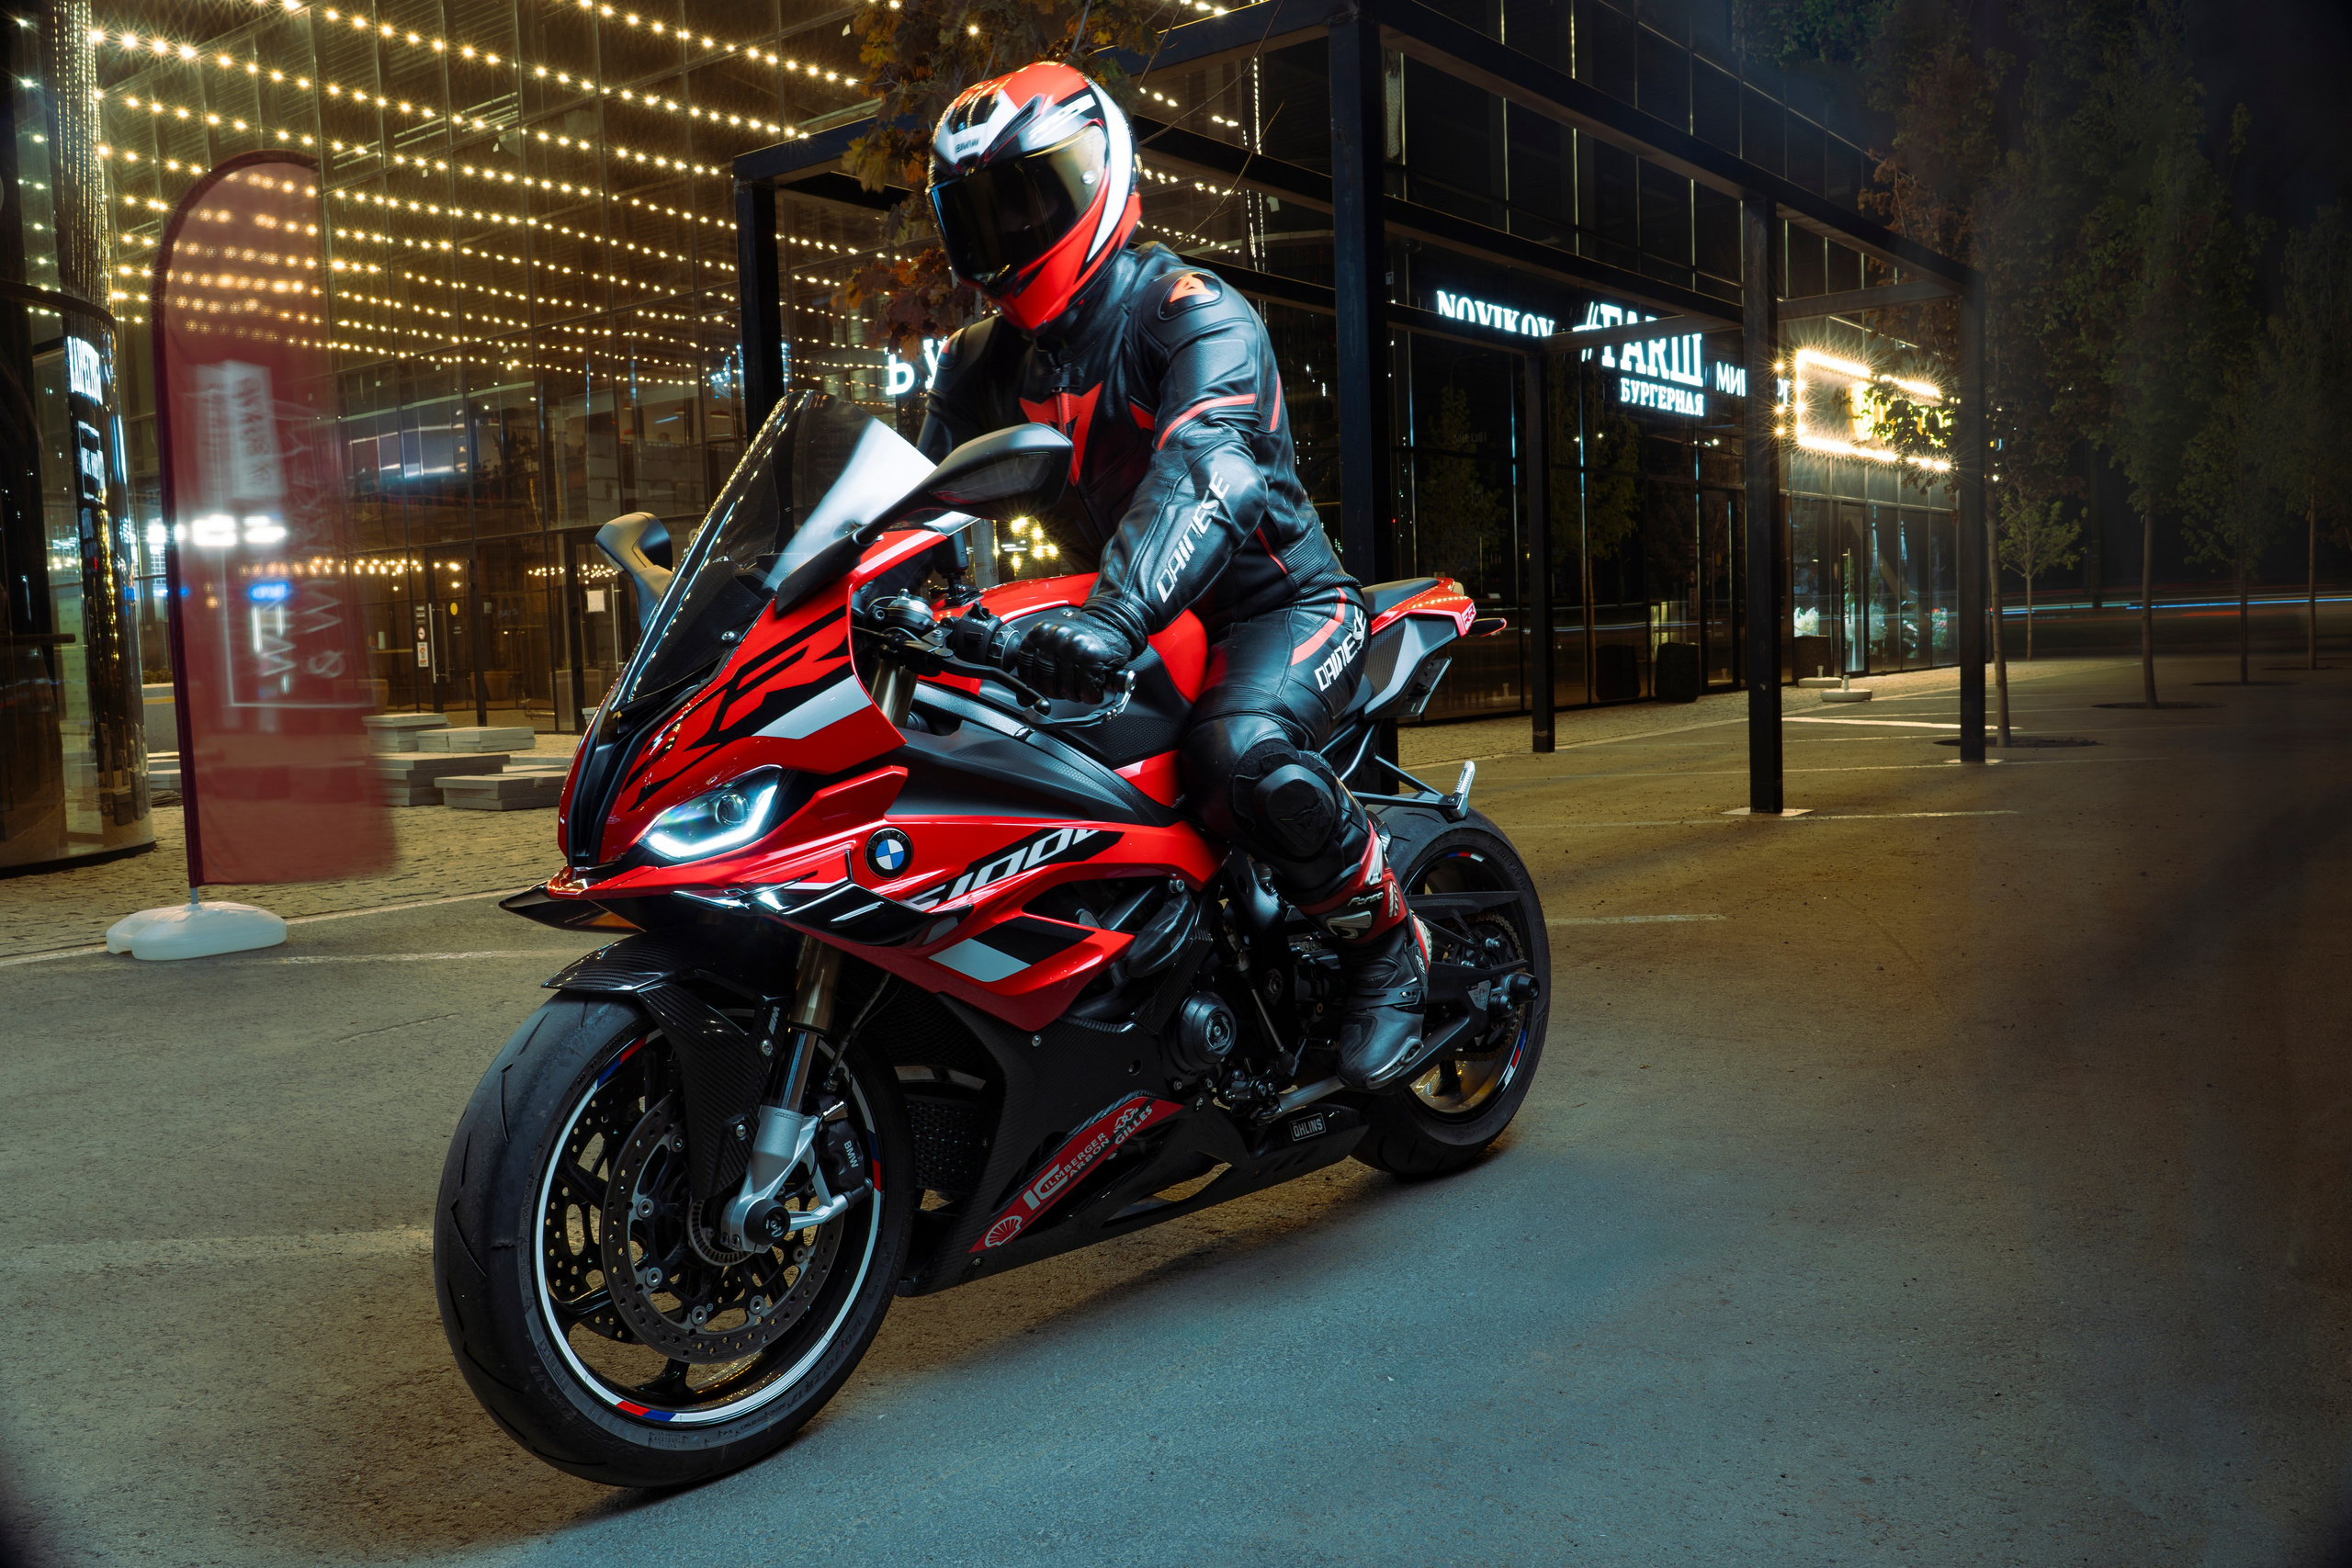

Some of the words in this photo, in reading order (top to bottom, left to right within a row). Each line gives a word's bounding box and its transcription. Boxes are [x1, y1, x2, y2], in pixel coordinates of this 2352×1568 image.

[956, 138, 980, 153] BMW
[1437, 290, 1555, 337] NOVIKOV
[1620, 378, 1704, 416] БУРГЕРНАЯ
[1156, 470, 1231, 604] DAINESE
[866, 830, 907, 851] BMW
[1114, 1105, 1153, 1145] GILLES
[1292, 1118, 1323, 1138] ÖHLINS
[843, 1140, 859, 1168] BMW
